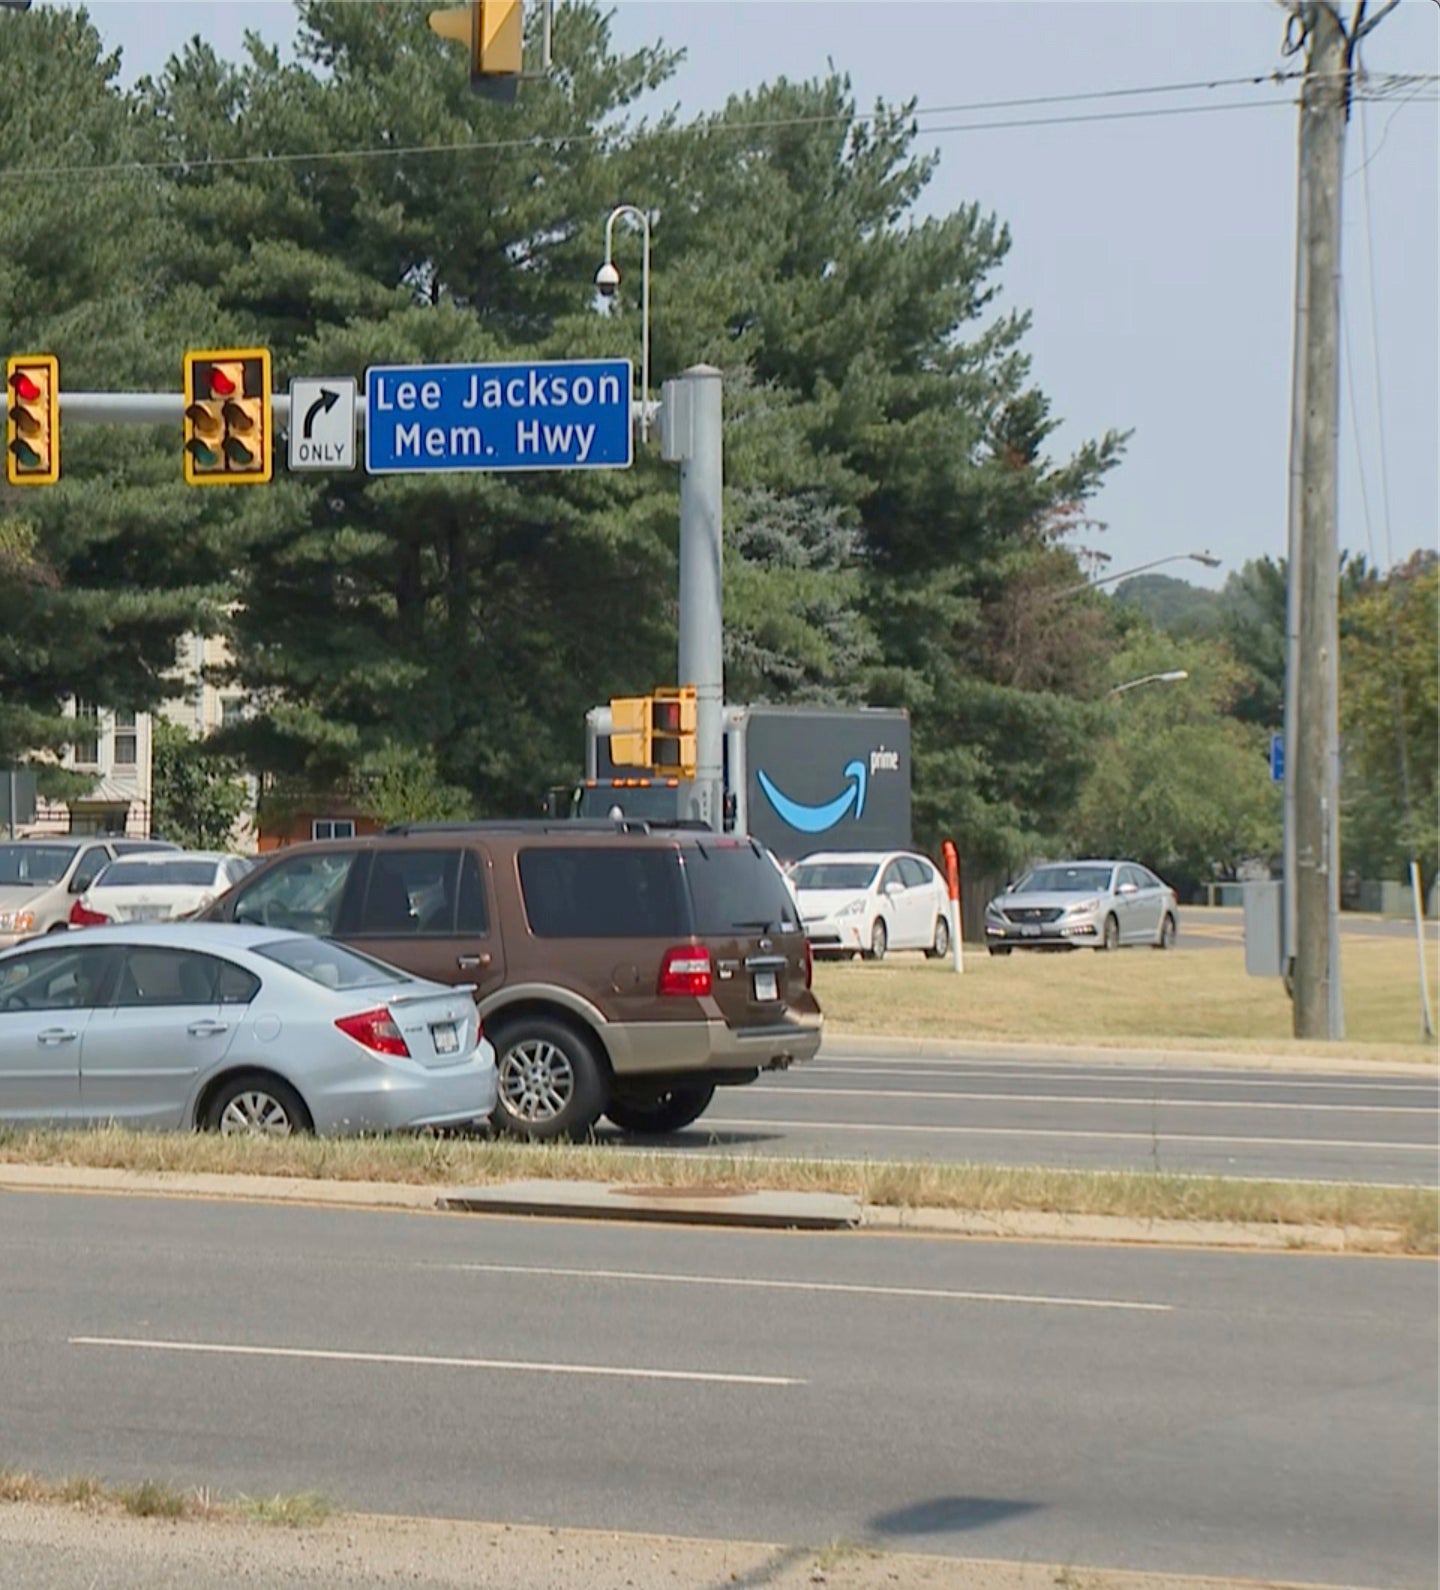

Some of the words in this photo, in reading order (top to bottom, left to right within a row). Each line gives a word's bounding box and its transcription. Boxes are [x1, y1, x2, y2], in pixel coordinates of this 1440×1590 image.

[377, 377, 441, 411] Lee
[463, 370, 619, 409] Jackson
[299, 444, 344, 462] ONLY
[395, 423, 494, 456] Mem.
[517, 419, 596, 462] Hwy
[871, 745, 899, 776] prime
